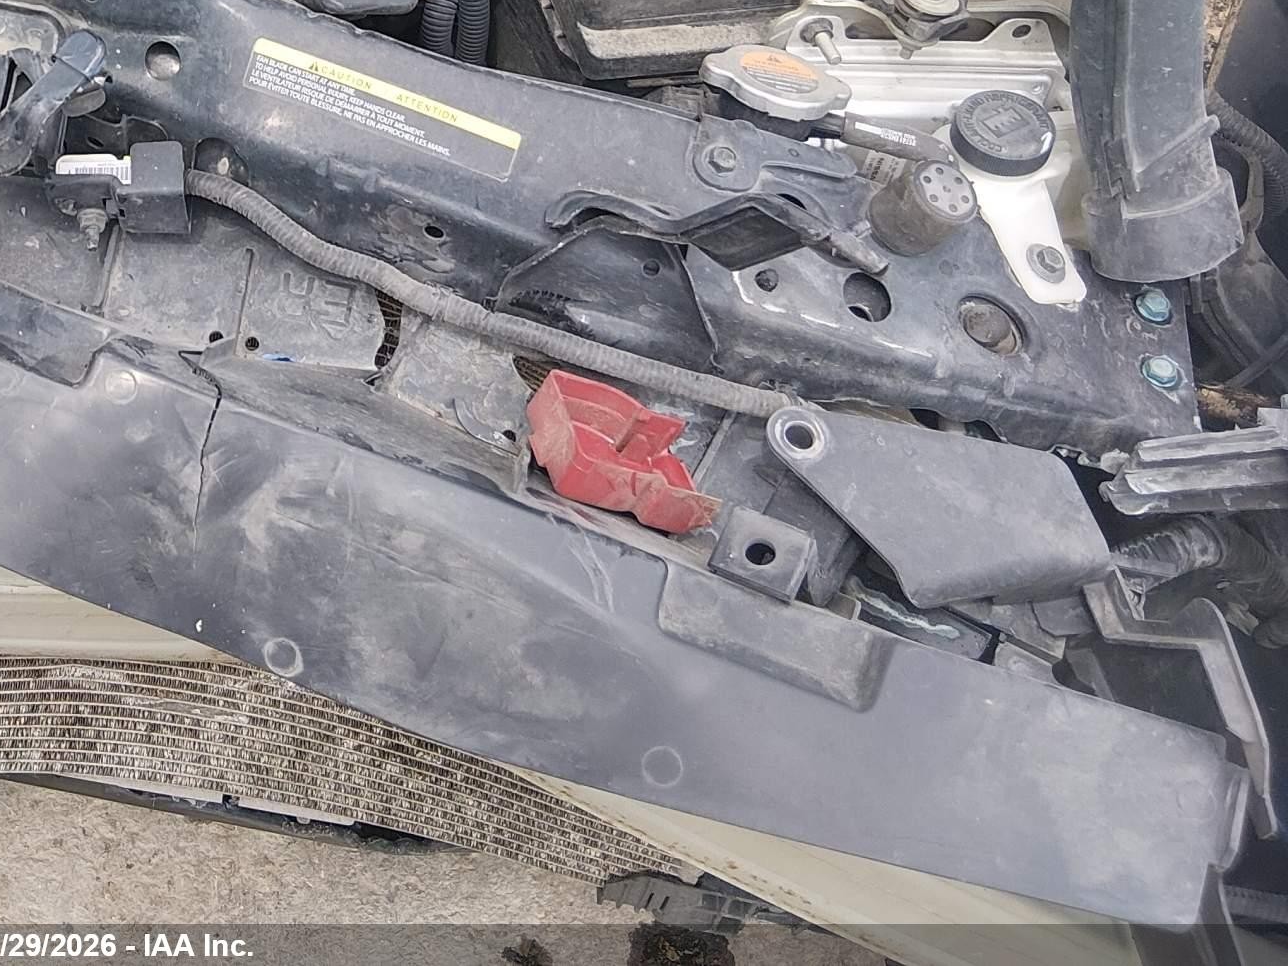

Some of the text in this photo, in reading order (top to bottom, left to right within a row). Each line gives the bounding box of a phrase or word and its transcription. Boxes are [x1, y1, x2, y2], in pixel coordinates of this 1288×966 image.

[251, 67, 261, 77] LE
[259, 70, 301, 92] VENTILATEUR
[300, 86, 325, 101] RISQUE
[324, 94, 334, 104] DE
[375, 114, 394, 126] TOUT
[254, 60, 264, 70] TO
[262, 63, 279, 75] HELP
[278, 69, 297, 82] AVOID
[296, 76, 327, 93] PERSONAL
[347, 95, 364, 107] KEEP
[363, 101, 385, 115] HANDS
[256, 53, 269, 64] FAN
[268, 58, 288, 71] BLADE
[287, 65, 302, 76] CAN
[301, 70, 319, 82] START
[318, 77, 327, 85] AT
[326, 80, 339, 90] ANY
[319, 64, 458, 122] CAUTION ATTENTION
[248, 74, 268, 88] POUR
[288, 89, 311, 104] TOUTE
[342, 109, 353, 120] NE
[352, 113, 366, 124] PAS
[365, 118, 376, 128] EN
[374, 121, 415, 143] APPROCHER
[414, 136, 427, 147] LES
